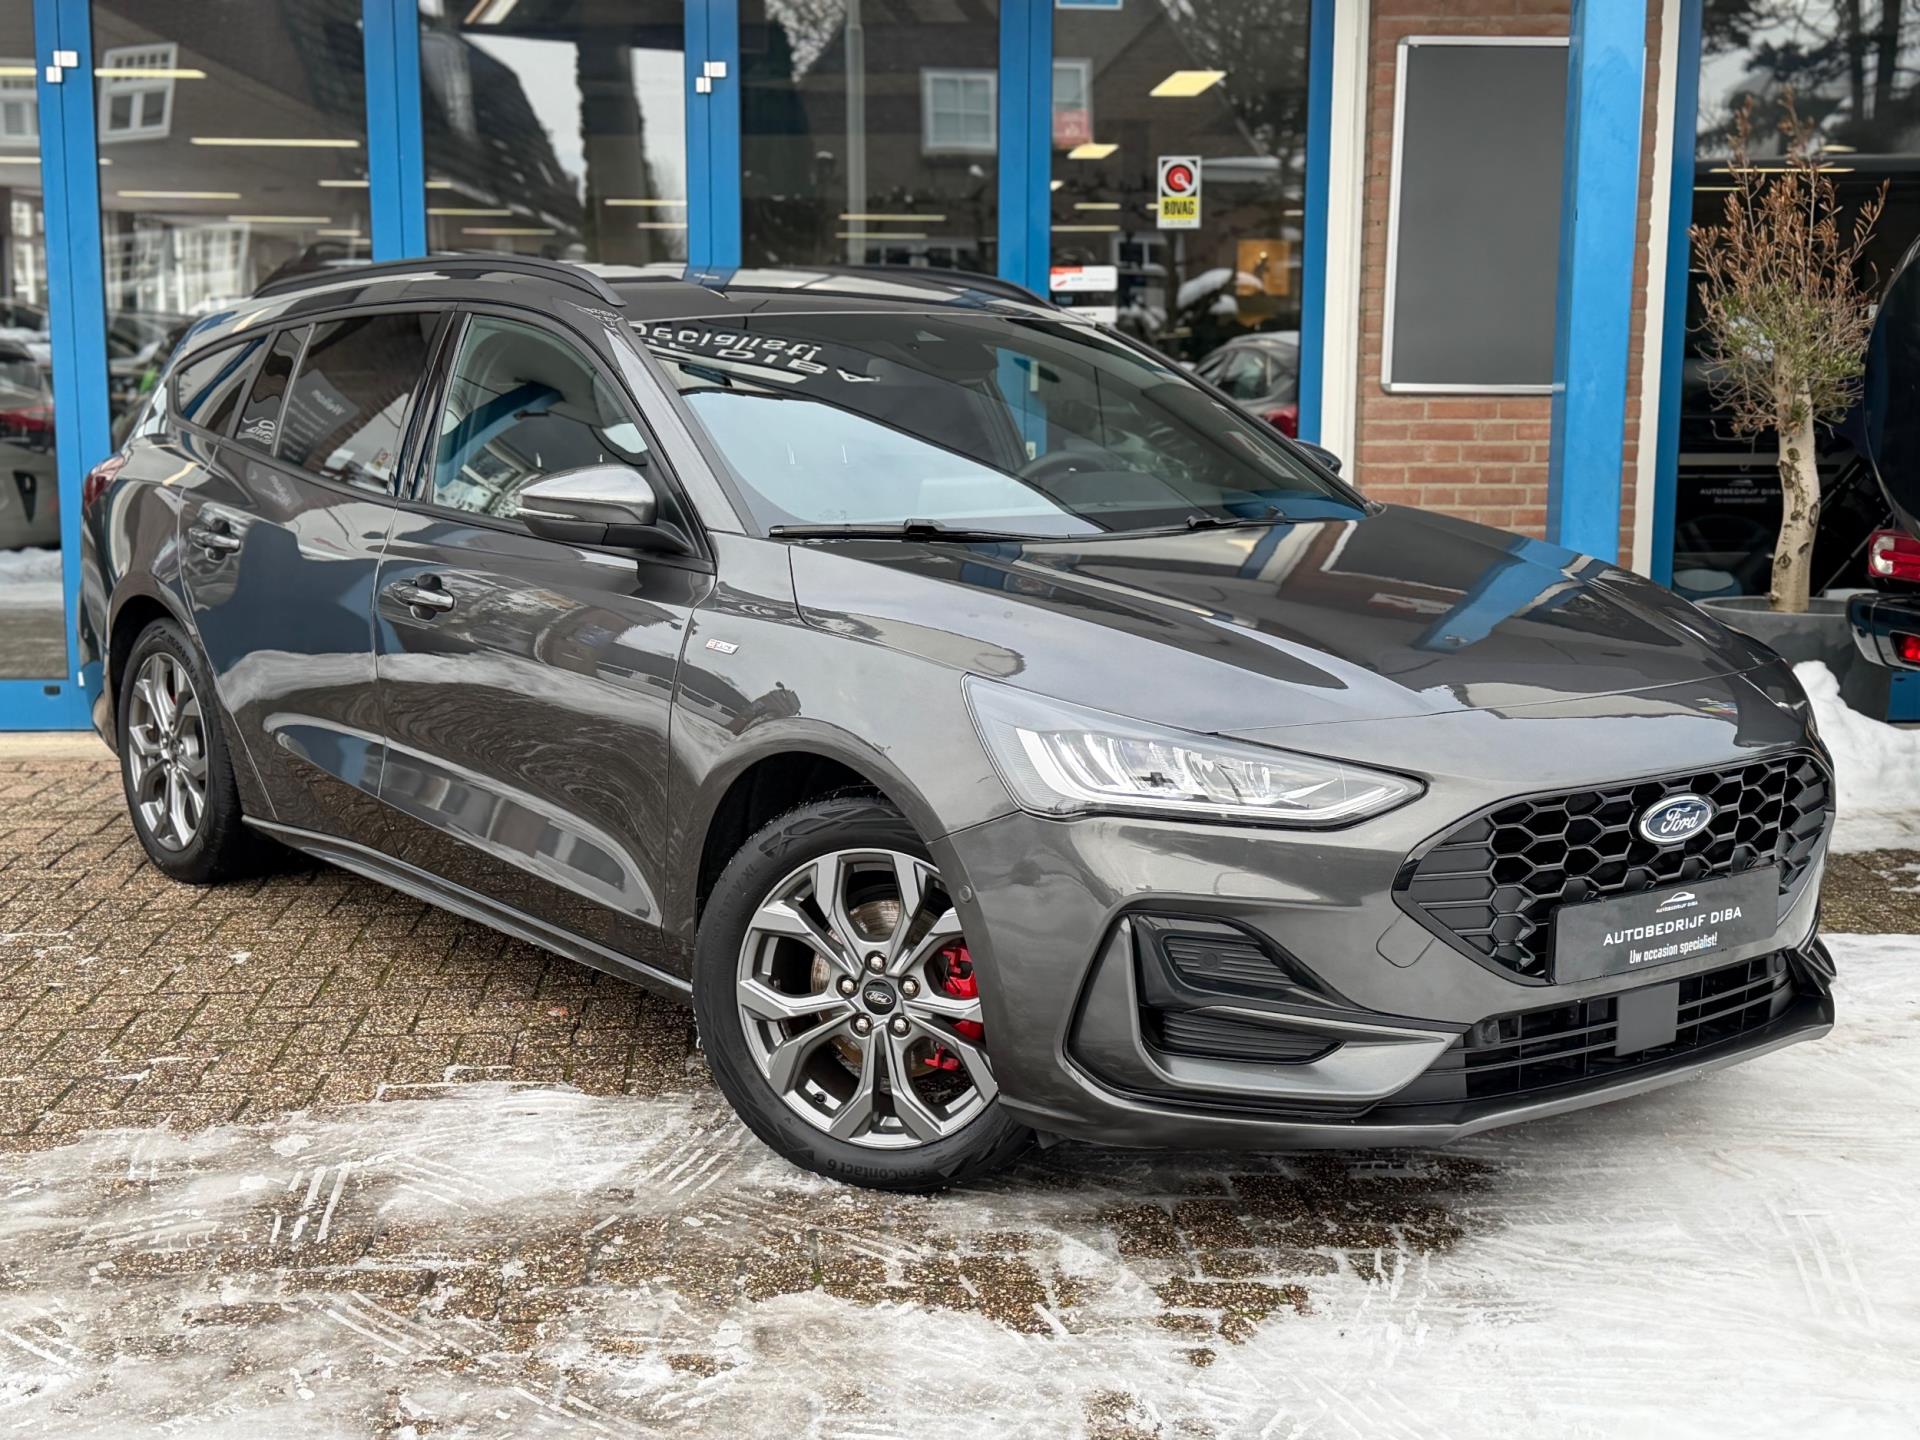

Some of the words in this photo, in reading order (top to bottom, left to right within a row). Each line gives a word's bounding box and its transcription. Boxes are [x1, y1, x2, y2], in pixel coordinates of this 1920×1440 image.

[1164, 201, 1194, 215] BOVAG
[1661, 806, 1699, 833] Ford
[1603, 914, 1707, 947] AUTOBEDRIJF
[1710, 906, 1742, 925] DIBA
[1629, 949, 1642, 964] Uw
[1643, 943, 1679, 962] occasion
[1679, 931, 1718, 955] specialist!
